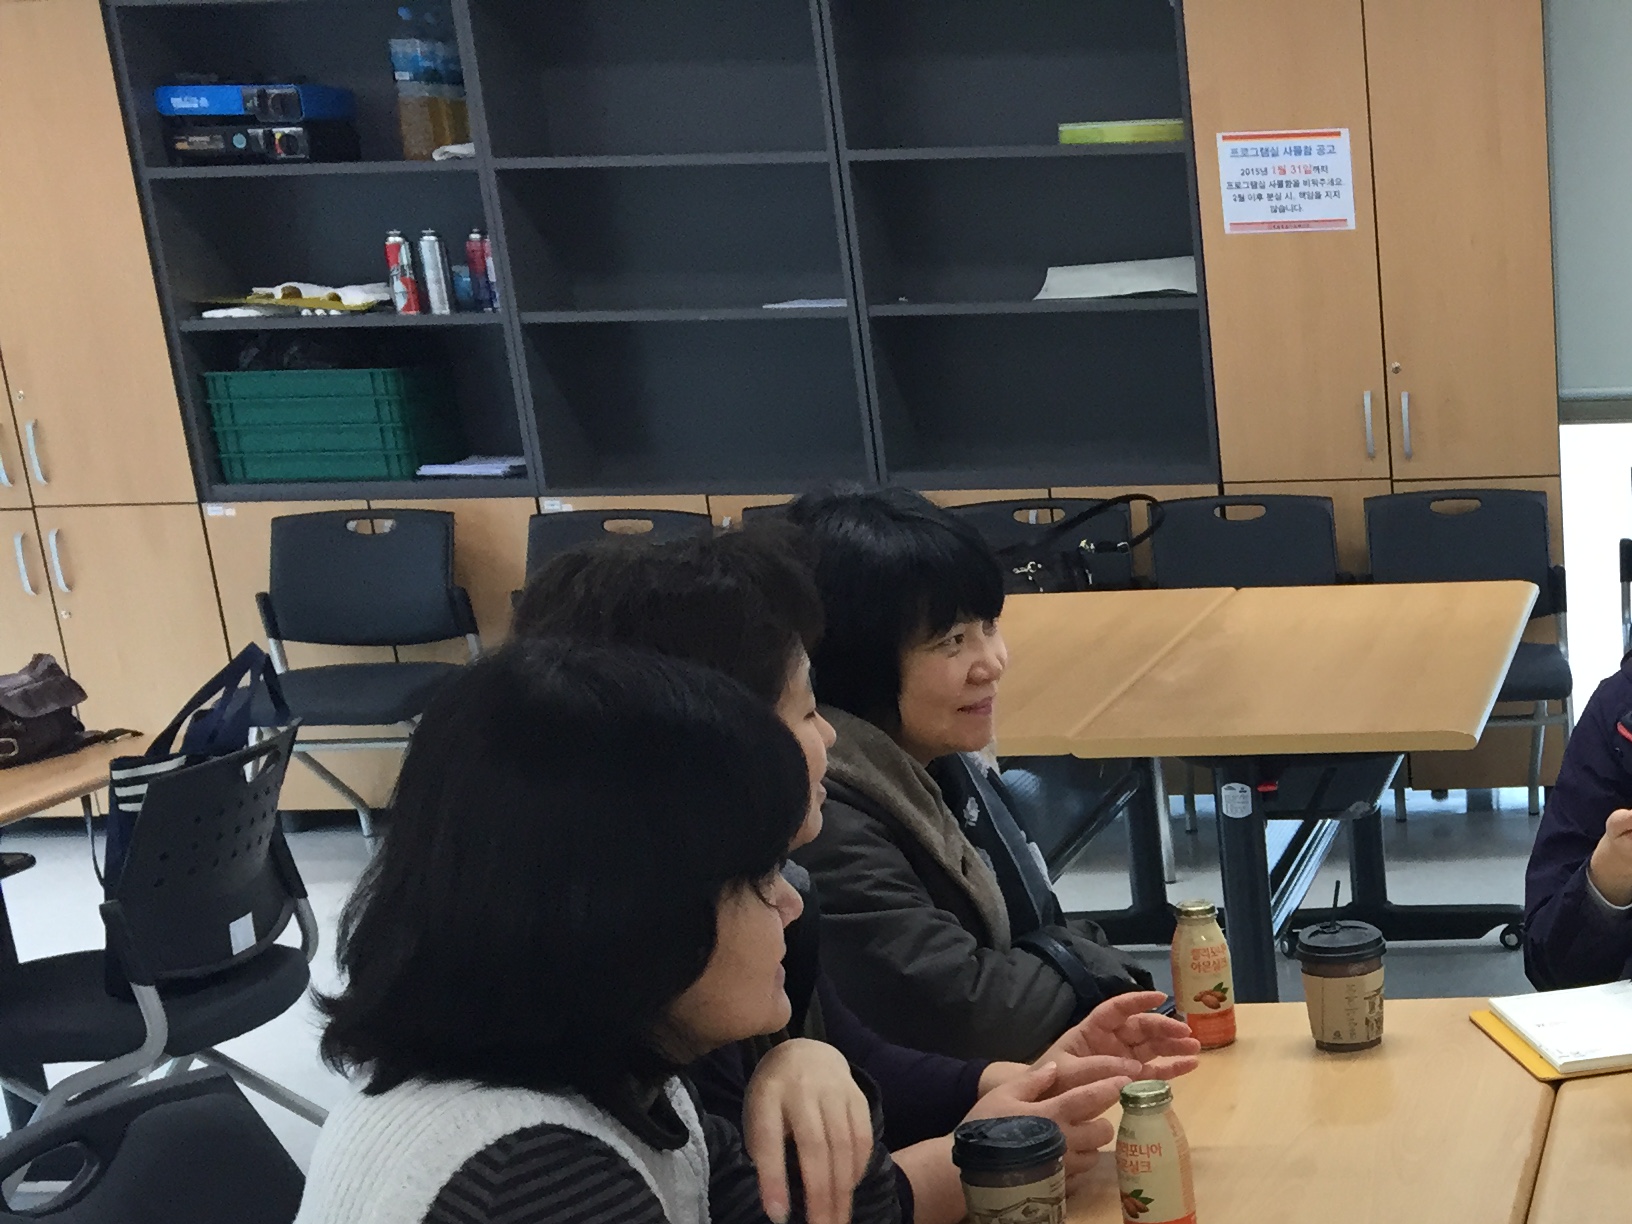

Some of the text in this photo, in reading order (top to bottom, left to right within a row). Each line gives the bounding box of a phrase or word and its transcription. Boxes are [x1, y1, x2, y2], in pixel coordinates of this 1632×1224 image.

[1230, 144, 1337, 158] 프로그램실 사물함 공고
[1240, 167, 1268, 177] 2015년
[1272, 165, 1287, 175] 1월
[1226, 180, 1266, 190] 프로그램실
[1268, 178, 1300, 189] 사물함을
